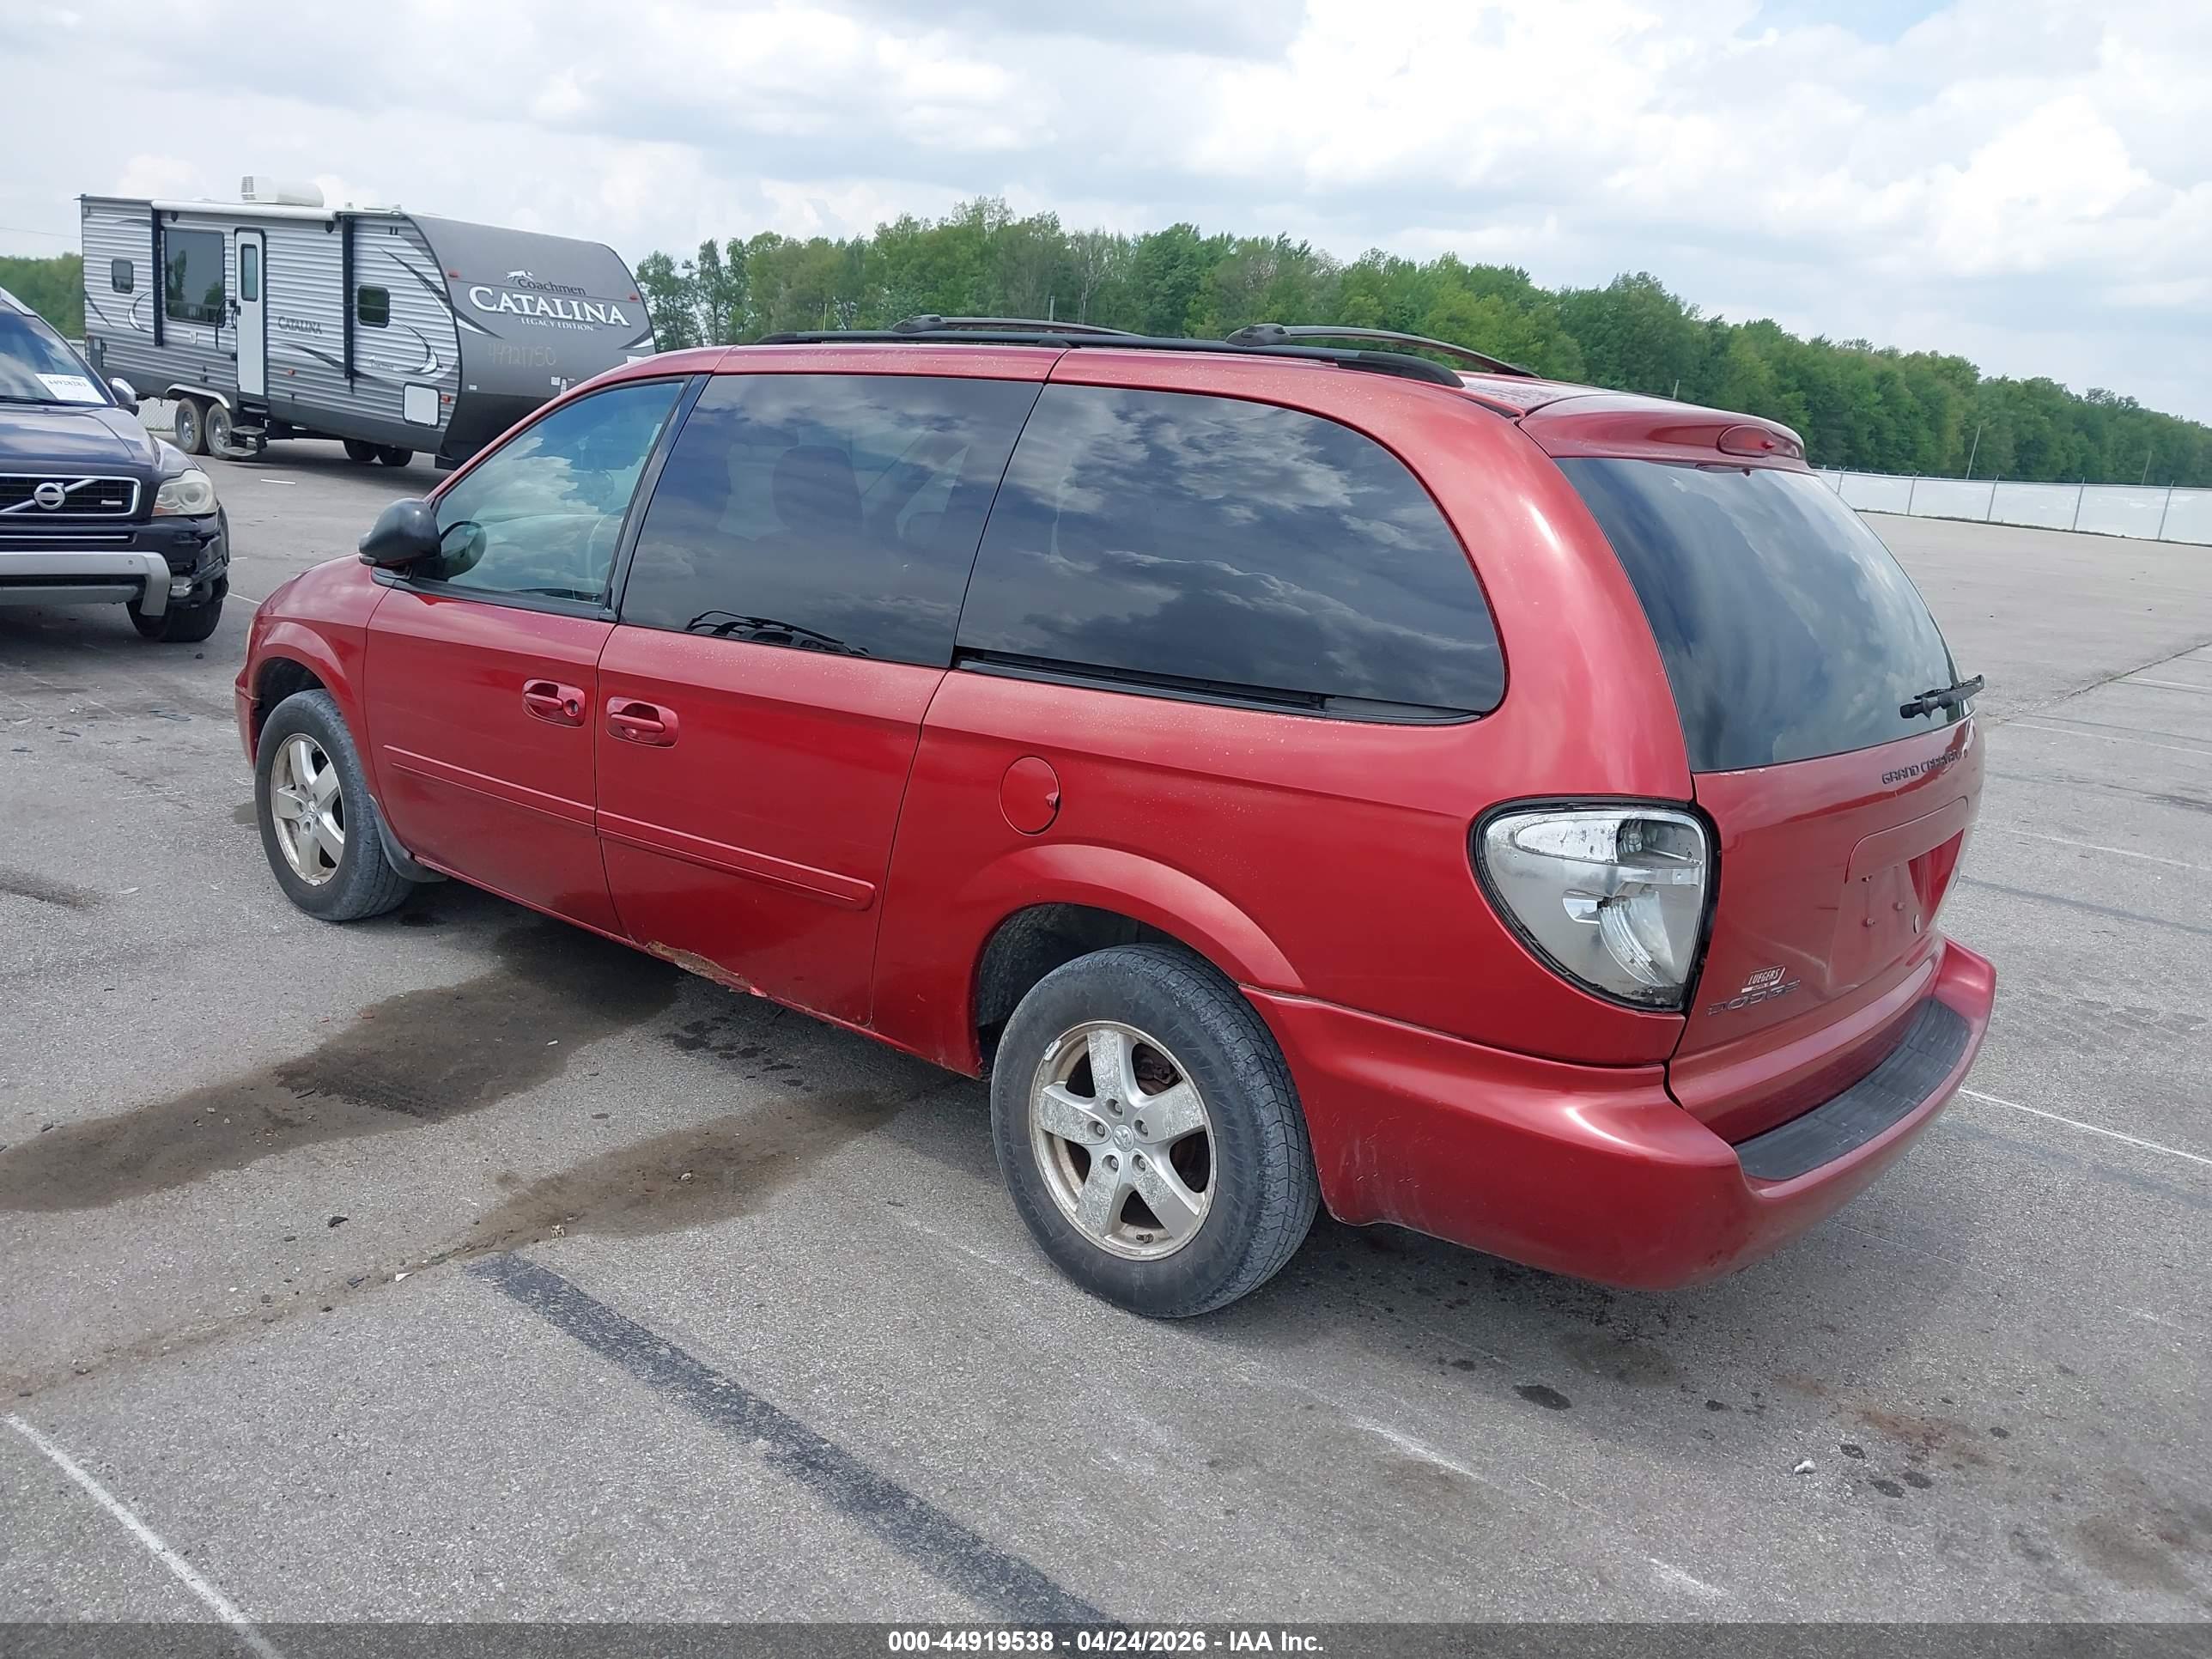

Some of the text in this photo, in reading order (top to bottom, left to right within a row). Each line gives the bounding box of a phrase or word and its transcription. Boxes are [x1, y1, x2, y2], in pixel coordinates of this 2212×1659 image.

[518, 278, 586, 295] Coachmen
[469, 286, 631, 327] CATALINA
[277, 316, 323, 335] CATALINA
[520, 317, 594, 331] LEGACY EDITION
[1881, 765, 1919, 785] GRAND
[1707, 980, 1801, 1016] DODGE
